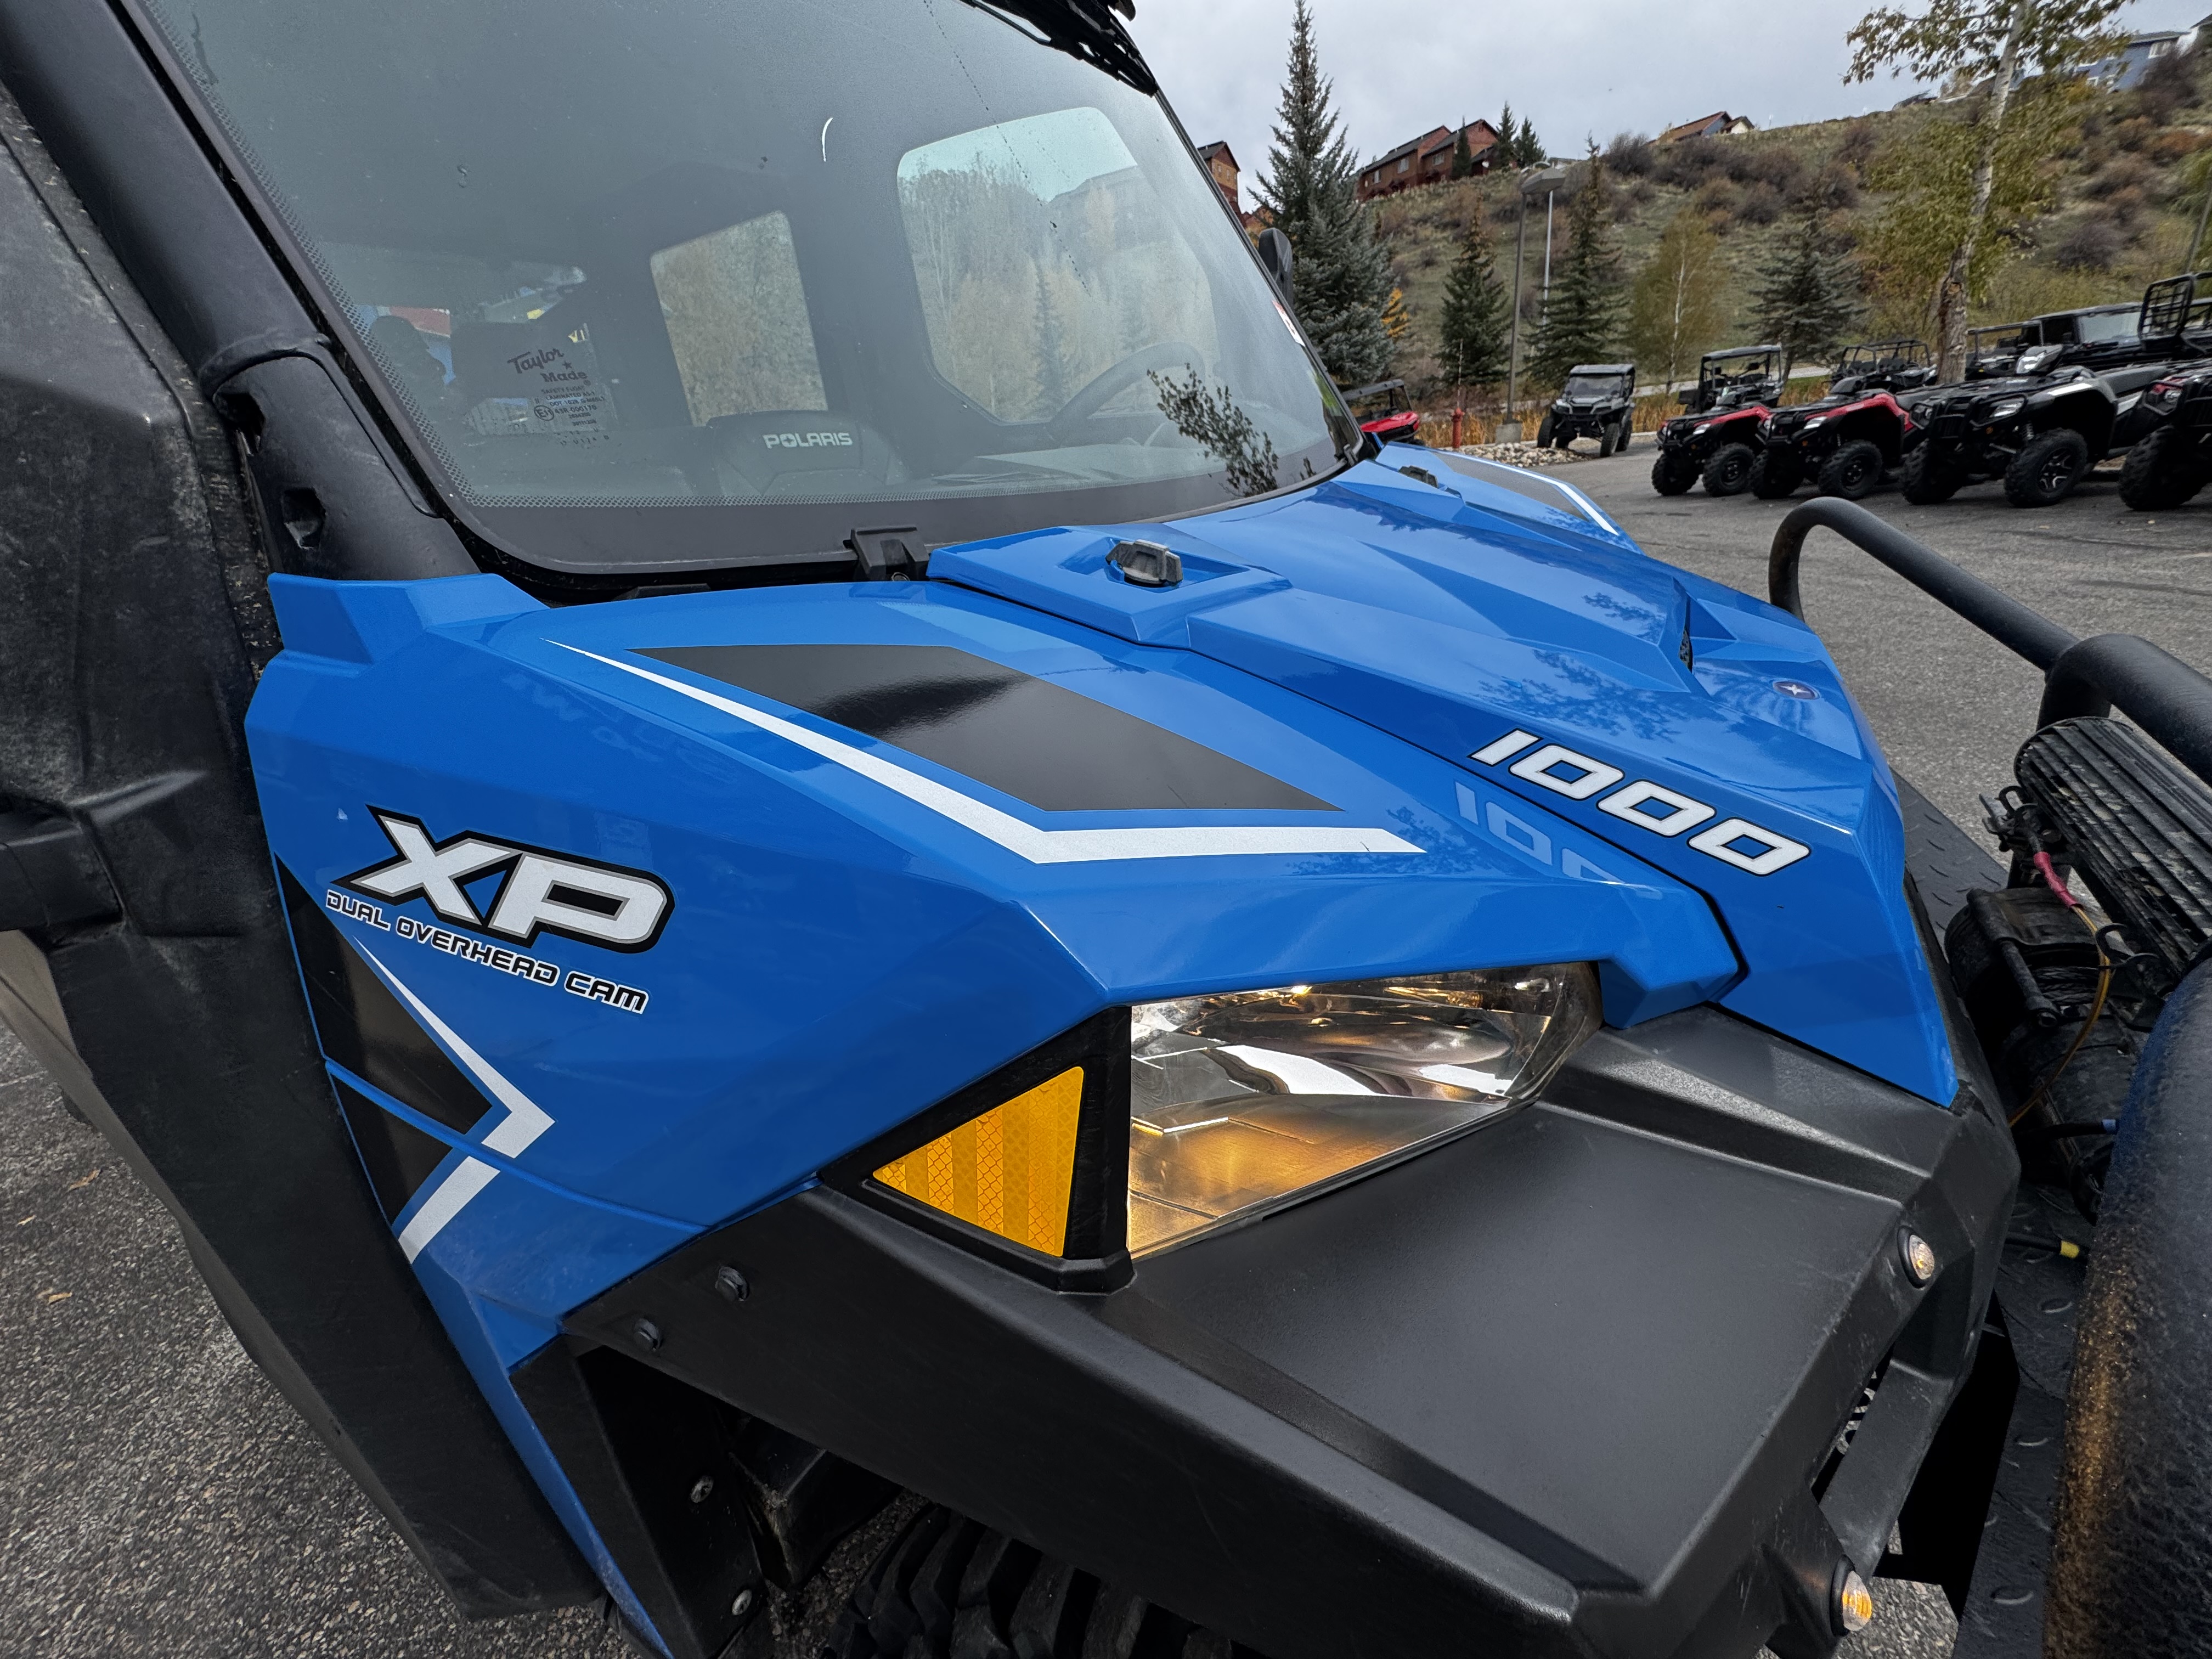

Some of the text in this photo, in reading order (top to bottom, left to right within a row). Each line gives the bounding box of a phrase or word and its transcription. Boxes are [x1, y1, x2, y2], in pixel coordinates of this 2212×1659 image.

[507, 348, 565, 374] Taylor
[540, 371, 588, 382] Made
[763, 432, 853, 449] POLARIS
[1468, 728, 1811, 877] 1000
[331, 804, 674, 953] XP
[326, 889, 648, 1014] DUAL OVERHEAD CAM
